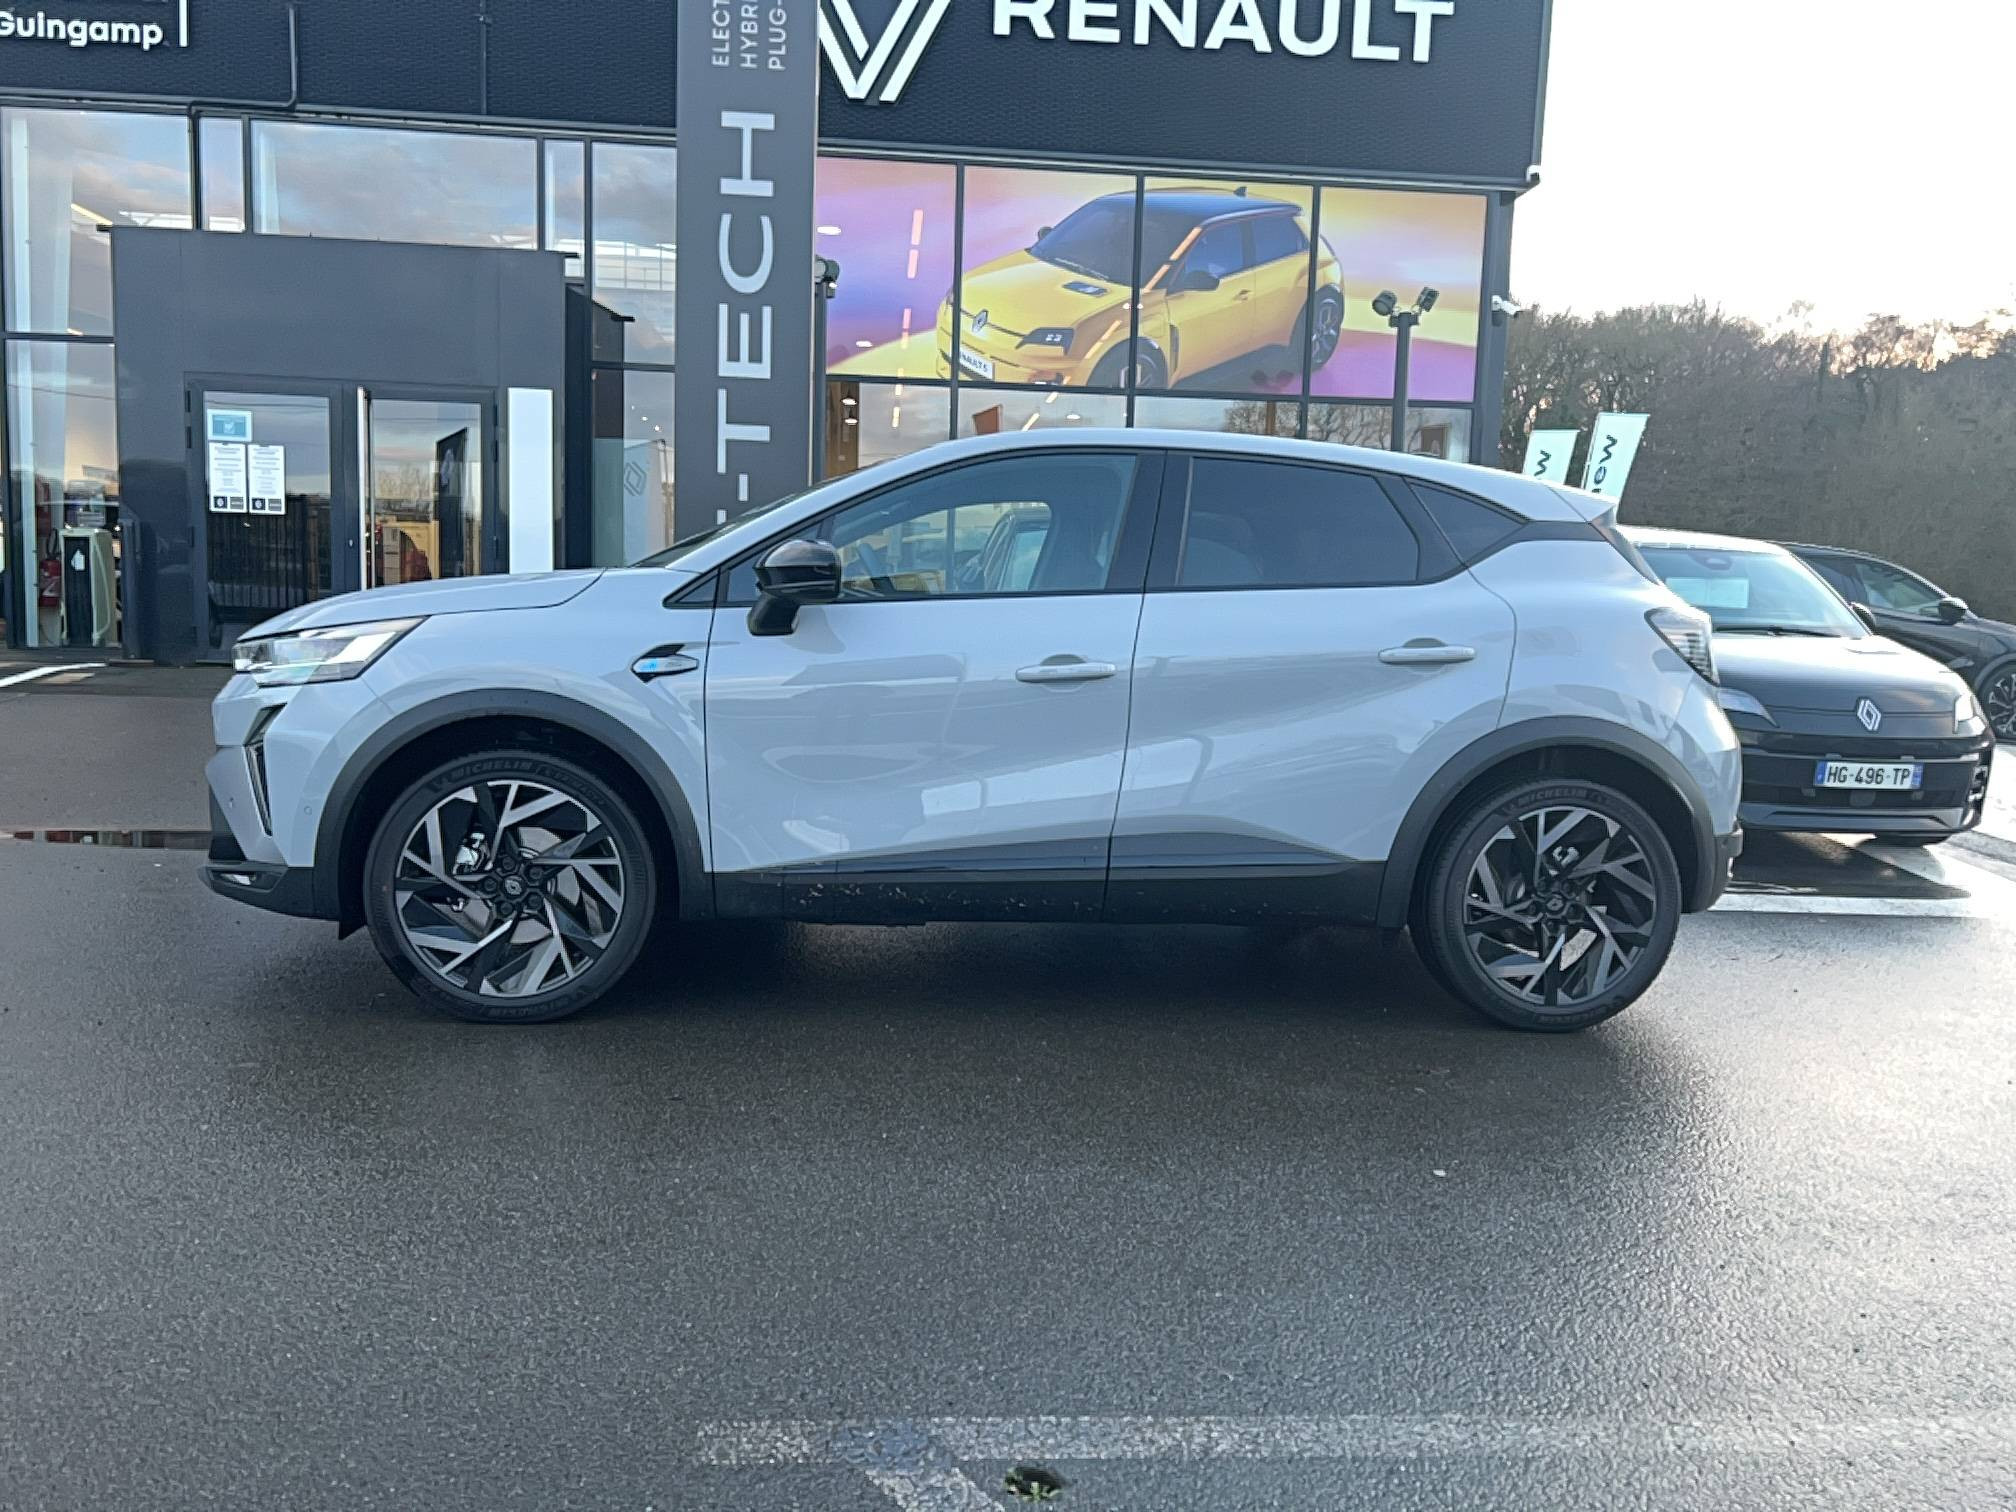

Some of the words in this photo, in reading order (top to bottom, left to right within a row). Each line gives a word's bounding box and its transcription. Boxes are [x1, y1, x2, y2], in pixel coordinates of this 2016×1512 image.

[0, 10, 164, 51] Guingamp
[992, 0, 1455, 63] RENAULT
[717, 110, 776, 525] -TECH
[1592, 434, 1618, 493] ew
[450, 760, 533, 780] MICHELIN
[1826, 765, 1911, 785] HG-496-TP
